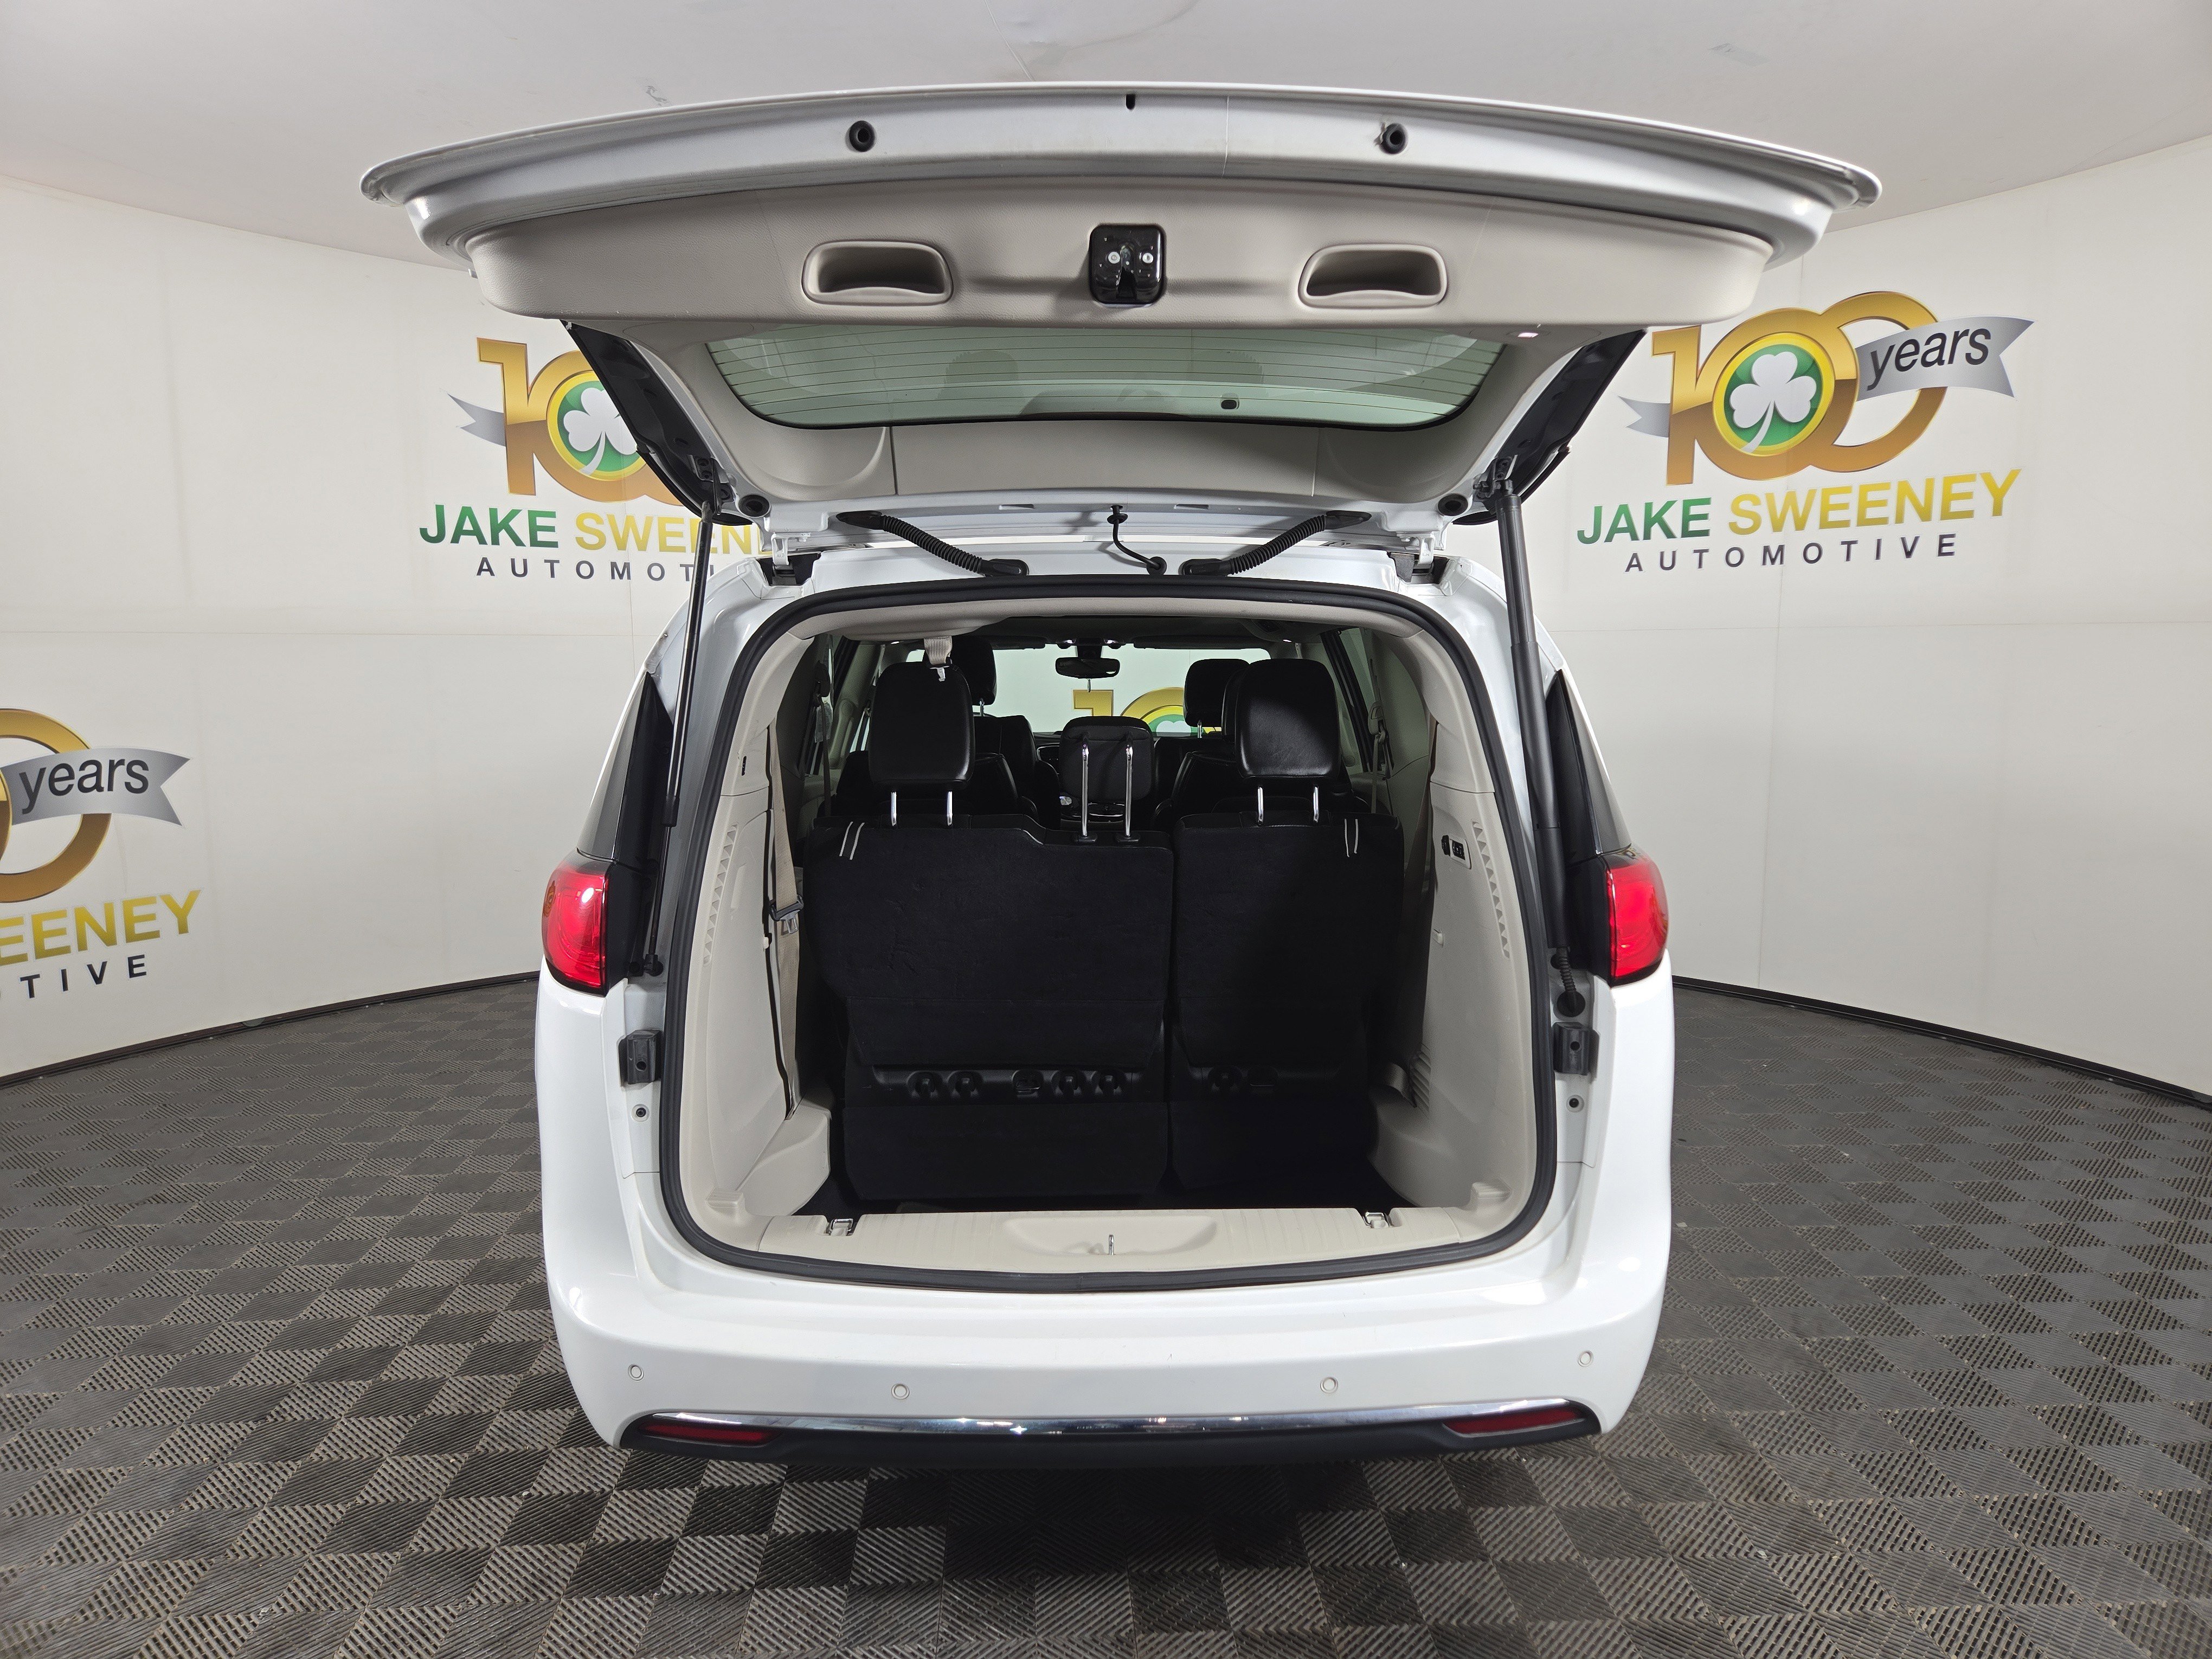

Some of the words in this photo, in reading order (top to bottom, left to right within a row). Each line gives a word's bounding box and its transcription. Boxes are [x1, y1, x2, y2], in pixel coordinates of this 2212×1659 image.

[1652, 291, 1947, 485] 100
[1867, 327, 1991, 390] years
[477, 337, 684, 503] 10
[419, 504, 558, 548] JAKE
[575, 512, 773, 555] SWEN
[1577, 497, 1712, 545] JAKE
[1728, 468, 2022, 535] SWEENEY
[1625, 533, 1956, 573] AUTOMOTIVE
[19, 759, 149, 814] years
[0, 954, 147, 999] TIVE
